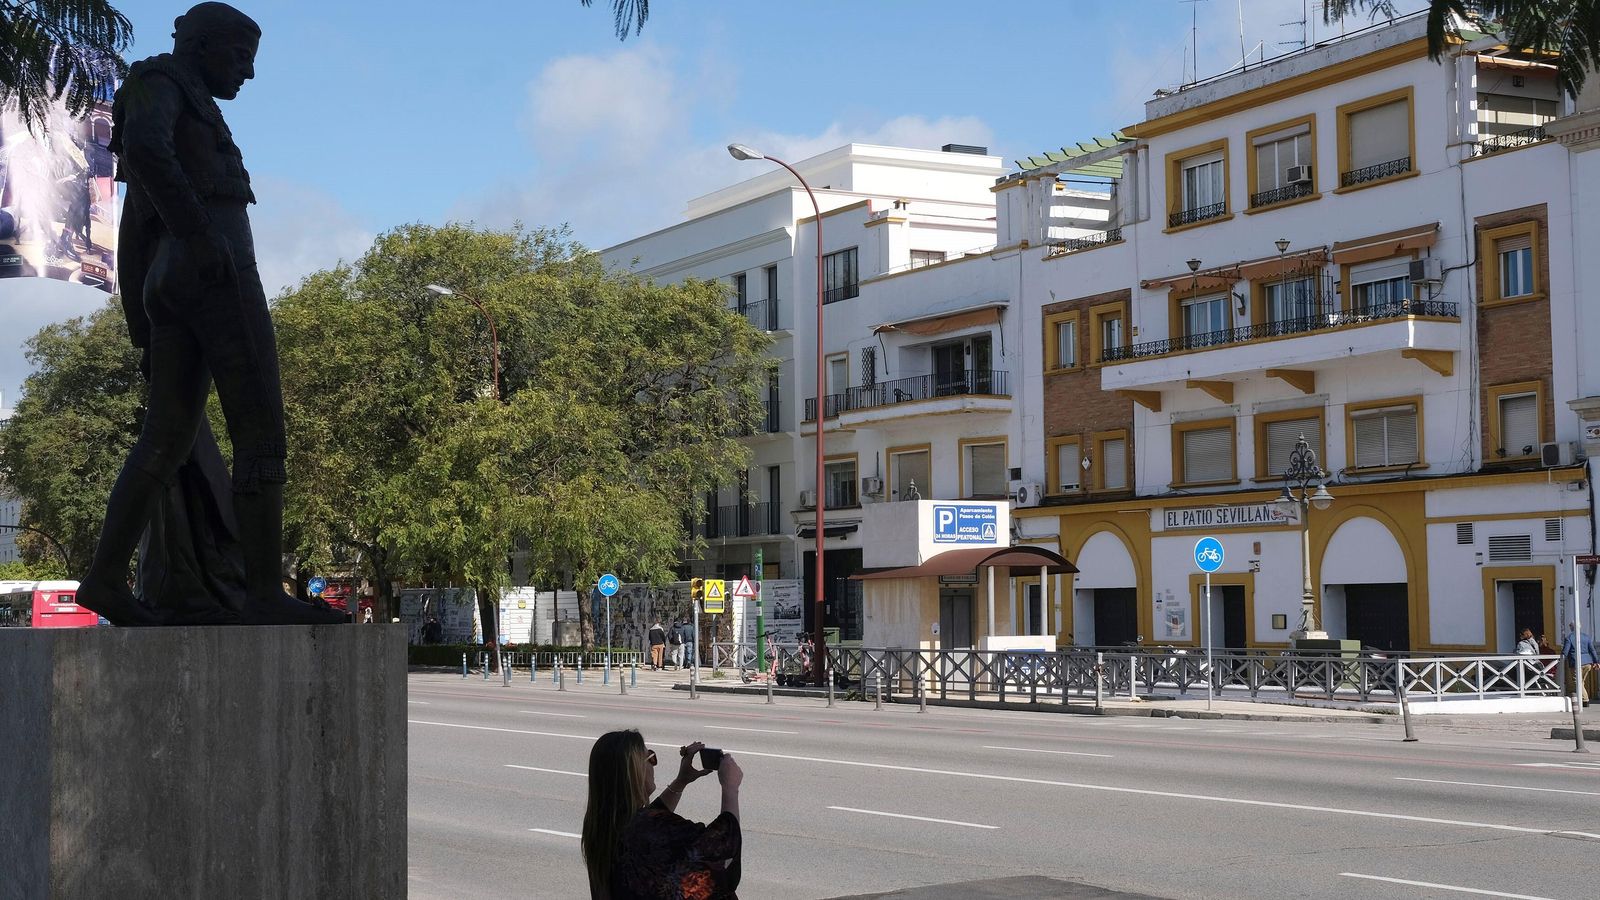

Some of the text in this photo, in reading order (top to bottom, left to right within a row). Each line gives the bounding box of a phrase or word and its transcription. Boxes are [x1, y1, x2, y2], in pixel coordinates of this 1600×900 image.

[940, 510, 954, 532] P
[1167, 511, 1179, 527] EL
[1182, 508, 1213, 526] PATIO
